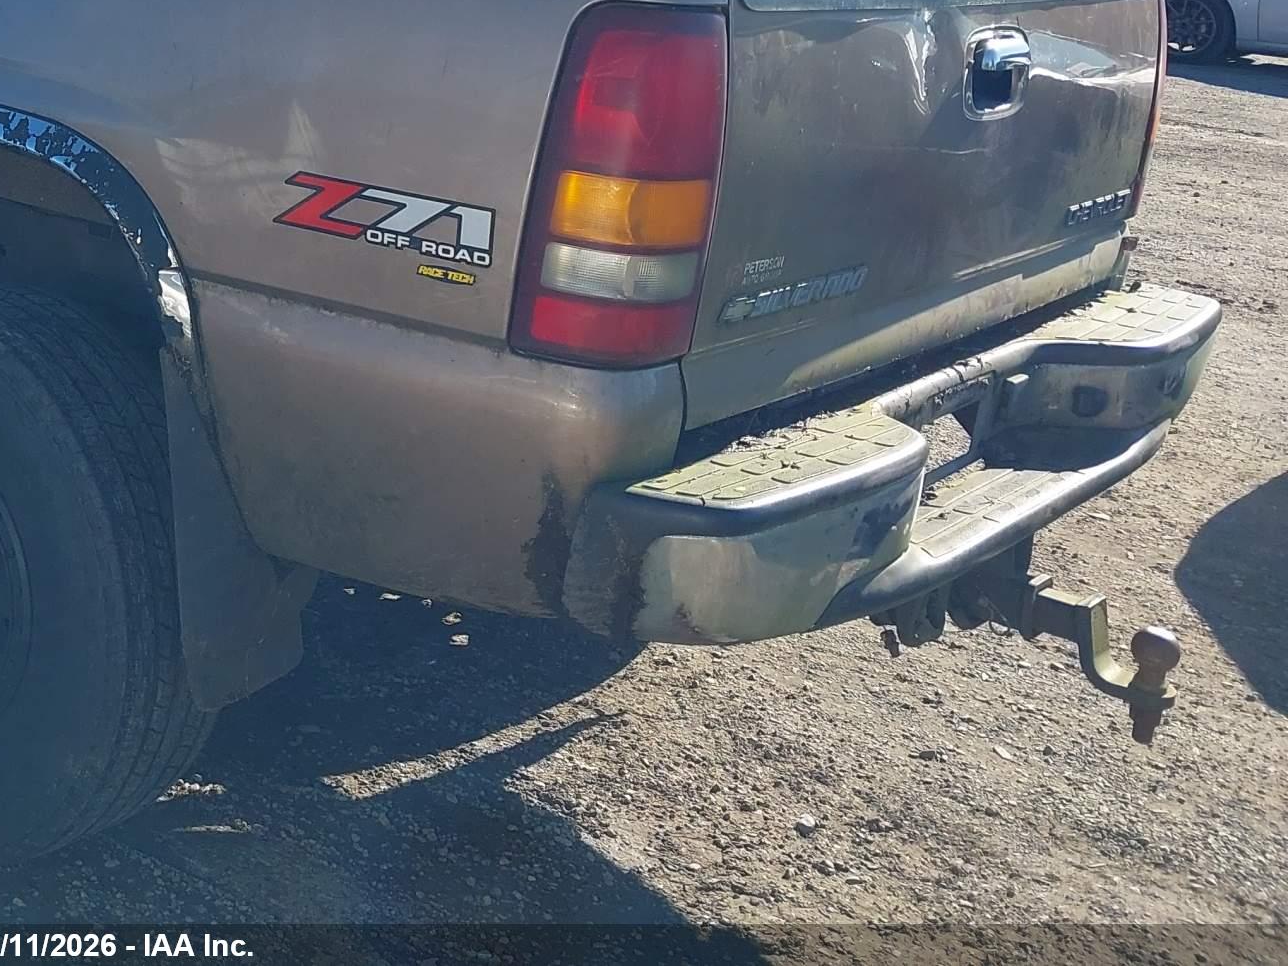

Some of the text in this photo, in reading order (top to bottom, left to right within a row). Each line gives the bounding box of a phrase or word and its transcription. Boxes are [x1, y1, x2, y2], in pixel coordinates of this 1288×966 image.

[273, 171, 496, 251] Z71
[365, 229, 491, 266] OFF ROAD
[744, 256, 785, 275] PETERSON
[418, 265, 475, 284] RACE TECH
[749, 265, 869, 318] SILVERADO
